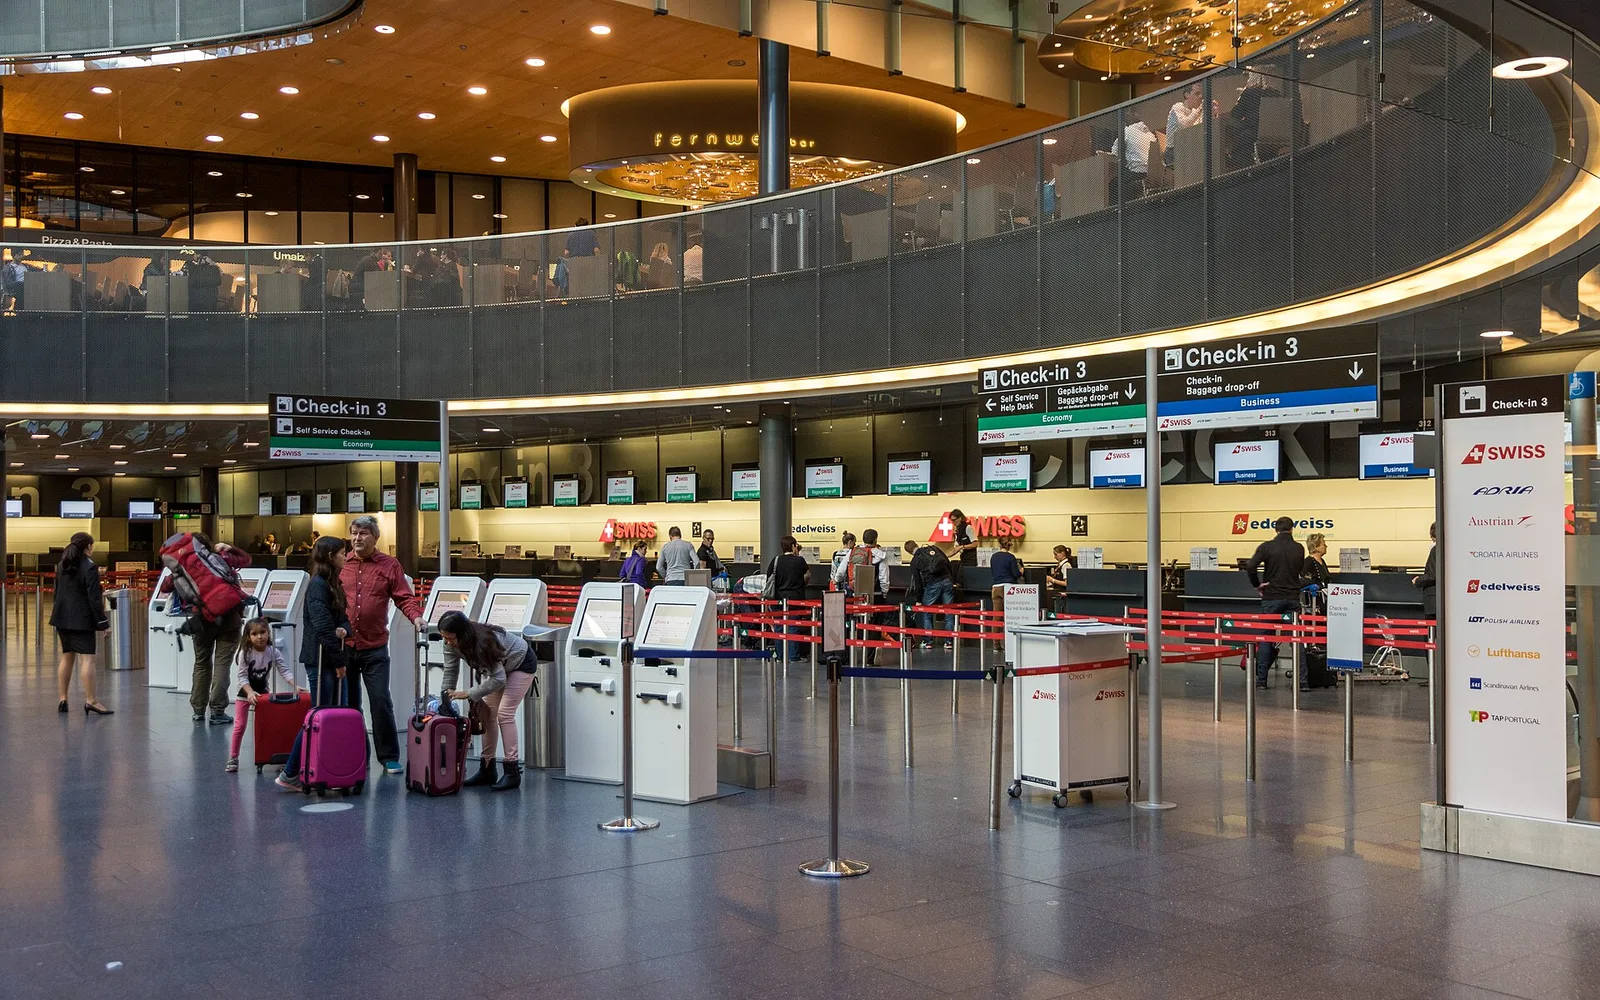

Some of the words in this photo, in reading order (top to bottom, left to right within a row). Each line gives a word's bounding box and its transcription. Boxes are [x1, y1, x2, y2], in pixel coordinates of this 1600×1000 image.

[654, 132, 759, 146] fernwe
[1186, 341, 1276, 368] Check-in
[1285, 337, 1298, 356] 3
[1000, 364, 1069, 387] Check-in
[1076, 361, 1086, 378] 3
[1186, 375, 1222, 386] Check-in
[1058, 384, 1108, 396] Gepäckabgabe
[1186, 384, 1222, 396] Baggage
[1225, 381, 1260, 393] drop-off
[1000, 394, 1013, 403] Self
[1015, 393, 1039, 402] Service
[1058, 395, 1088, 405] Baggage
[1090, 392, 1119, 402] drop-off
[1240, 397, 1280, 407] Business
[296, 398, 370, 415] Check-in
[377, 402, 387, 416] 3
[1000, 404, 1015, 412] Help
[1017, 402, 1034, 410] Desk
[1492, 399, 1537, 410] Check-in
[1541, 398, 1548, 406] 3
[1042, 414, 1073, 423] Economy
[1170, 418, 1192, 427] SWISS
[343, 440, 374, 449] Economy
[1488, 444, 1546, 460] SWISS
[1472, 485, 1534, 496] ADRIA
[966, 515, 1026, 537] WISS
[1251, 518, 1334, 529] edeeiss
[1468, 516, 1514, 526] Austrian
[616, 521, 657, 539] SWISS
[792, 524, 836, 533] edelweiss
[1480, 583, 1540, 592] edelweiss
[1487, 648, 1540, 660] Lufthansa
[1483, 682, 1518, 690] Scandinavian
[1469, 710, 1489, 723] TAP
[1504, 715, 1540, 725] PORTUGAL
